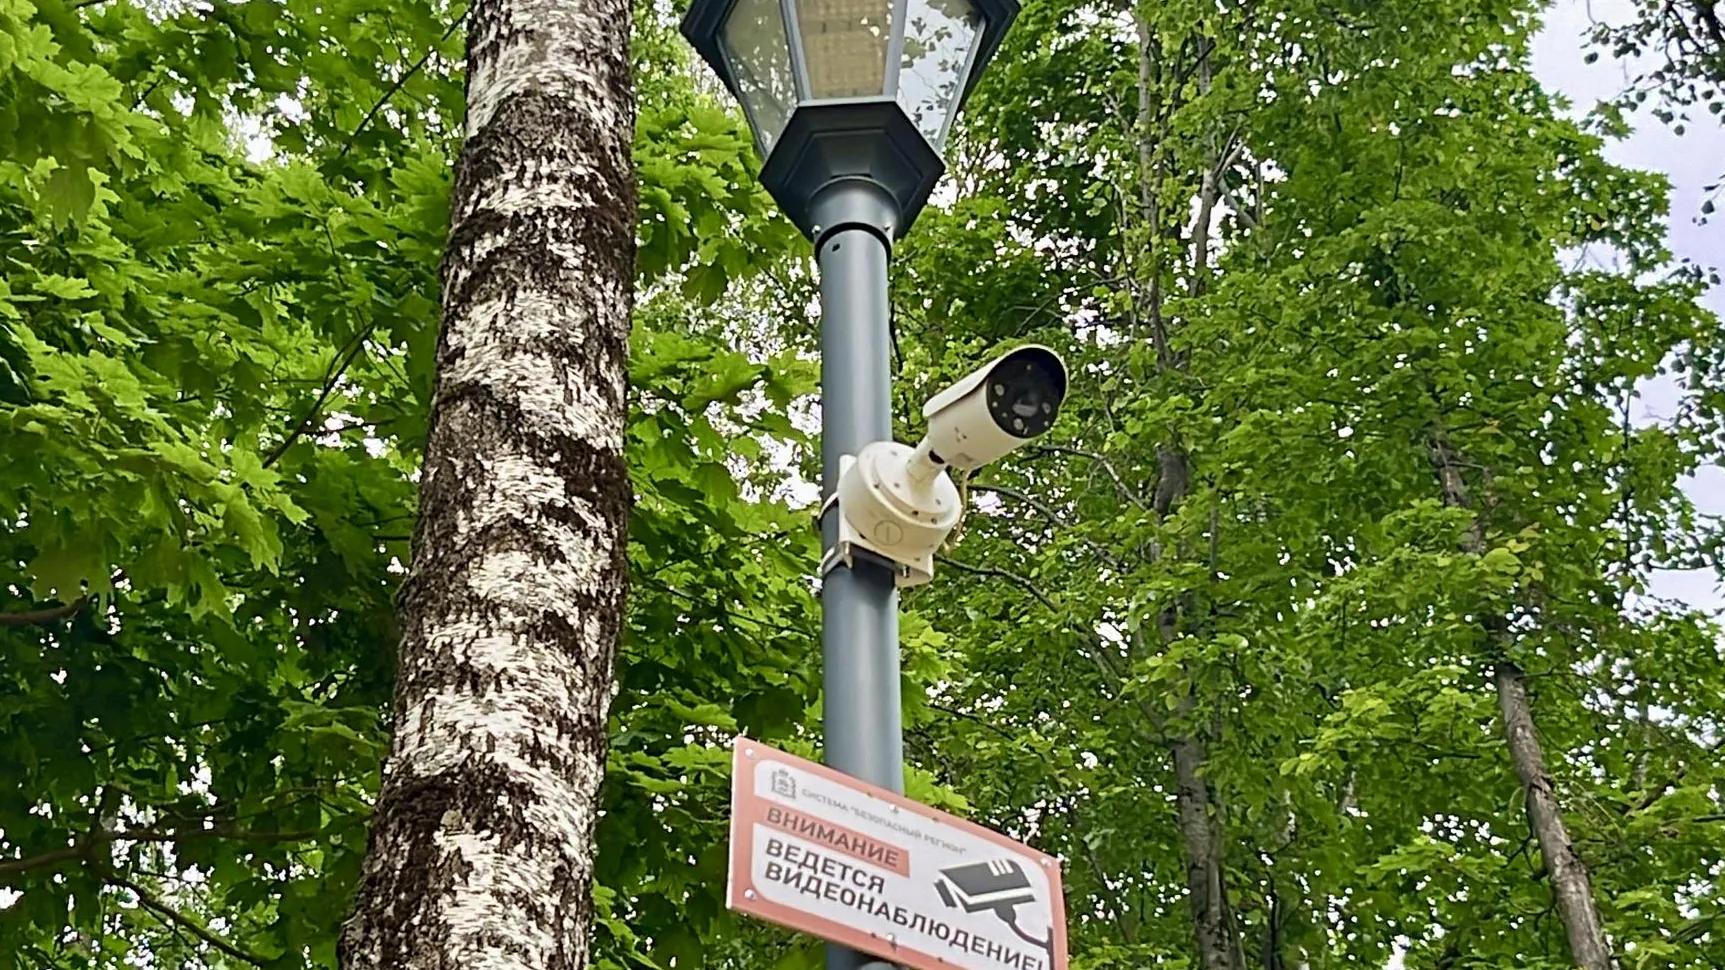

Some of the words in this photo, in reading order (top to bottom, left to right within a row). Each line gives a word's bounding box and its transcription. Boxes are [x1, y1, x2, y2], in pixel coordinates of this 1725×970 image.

[802, 788, 849, 812] СИСТЕМА
[767, 806, 899, 867] ВНИМАНИЕ
[766, 838, 885, 894] ВЕДЕТСЯ
[765, 861, 1046, 970] ВИДЕОНАБЛЮДЕНИЕ!
